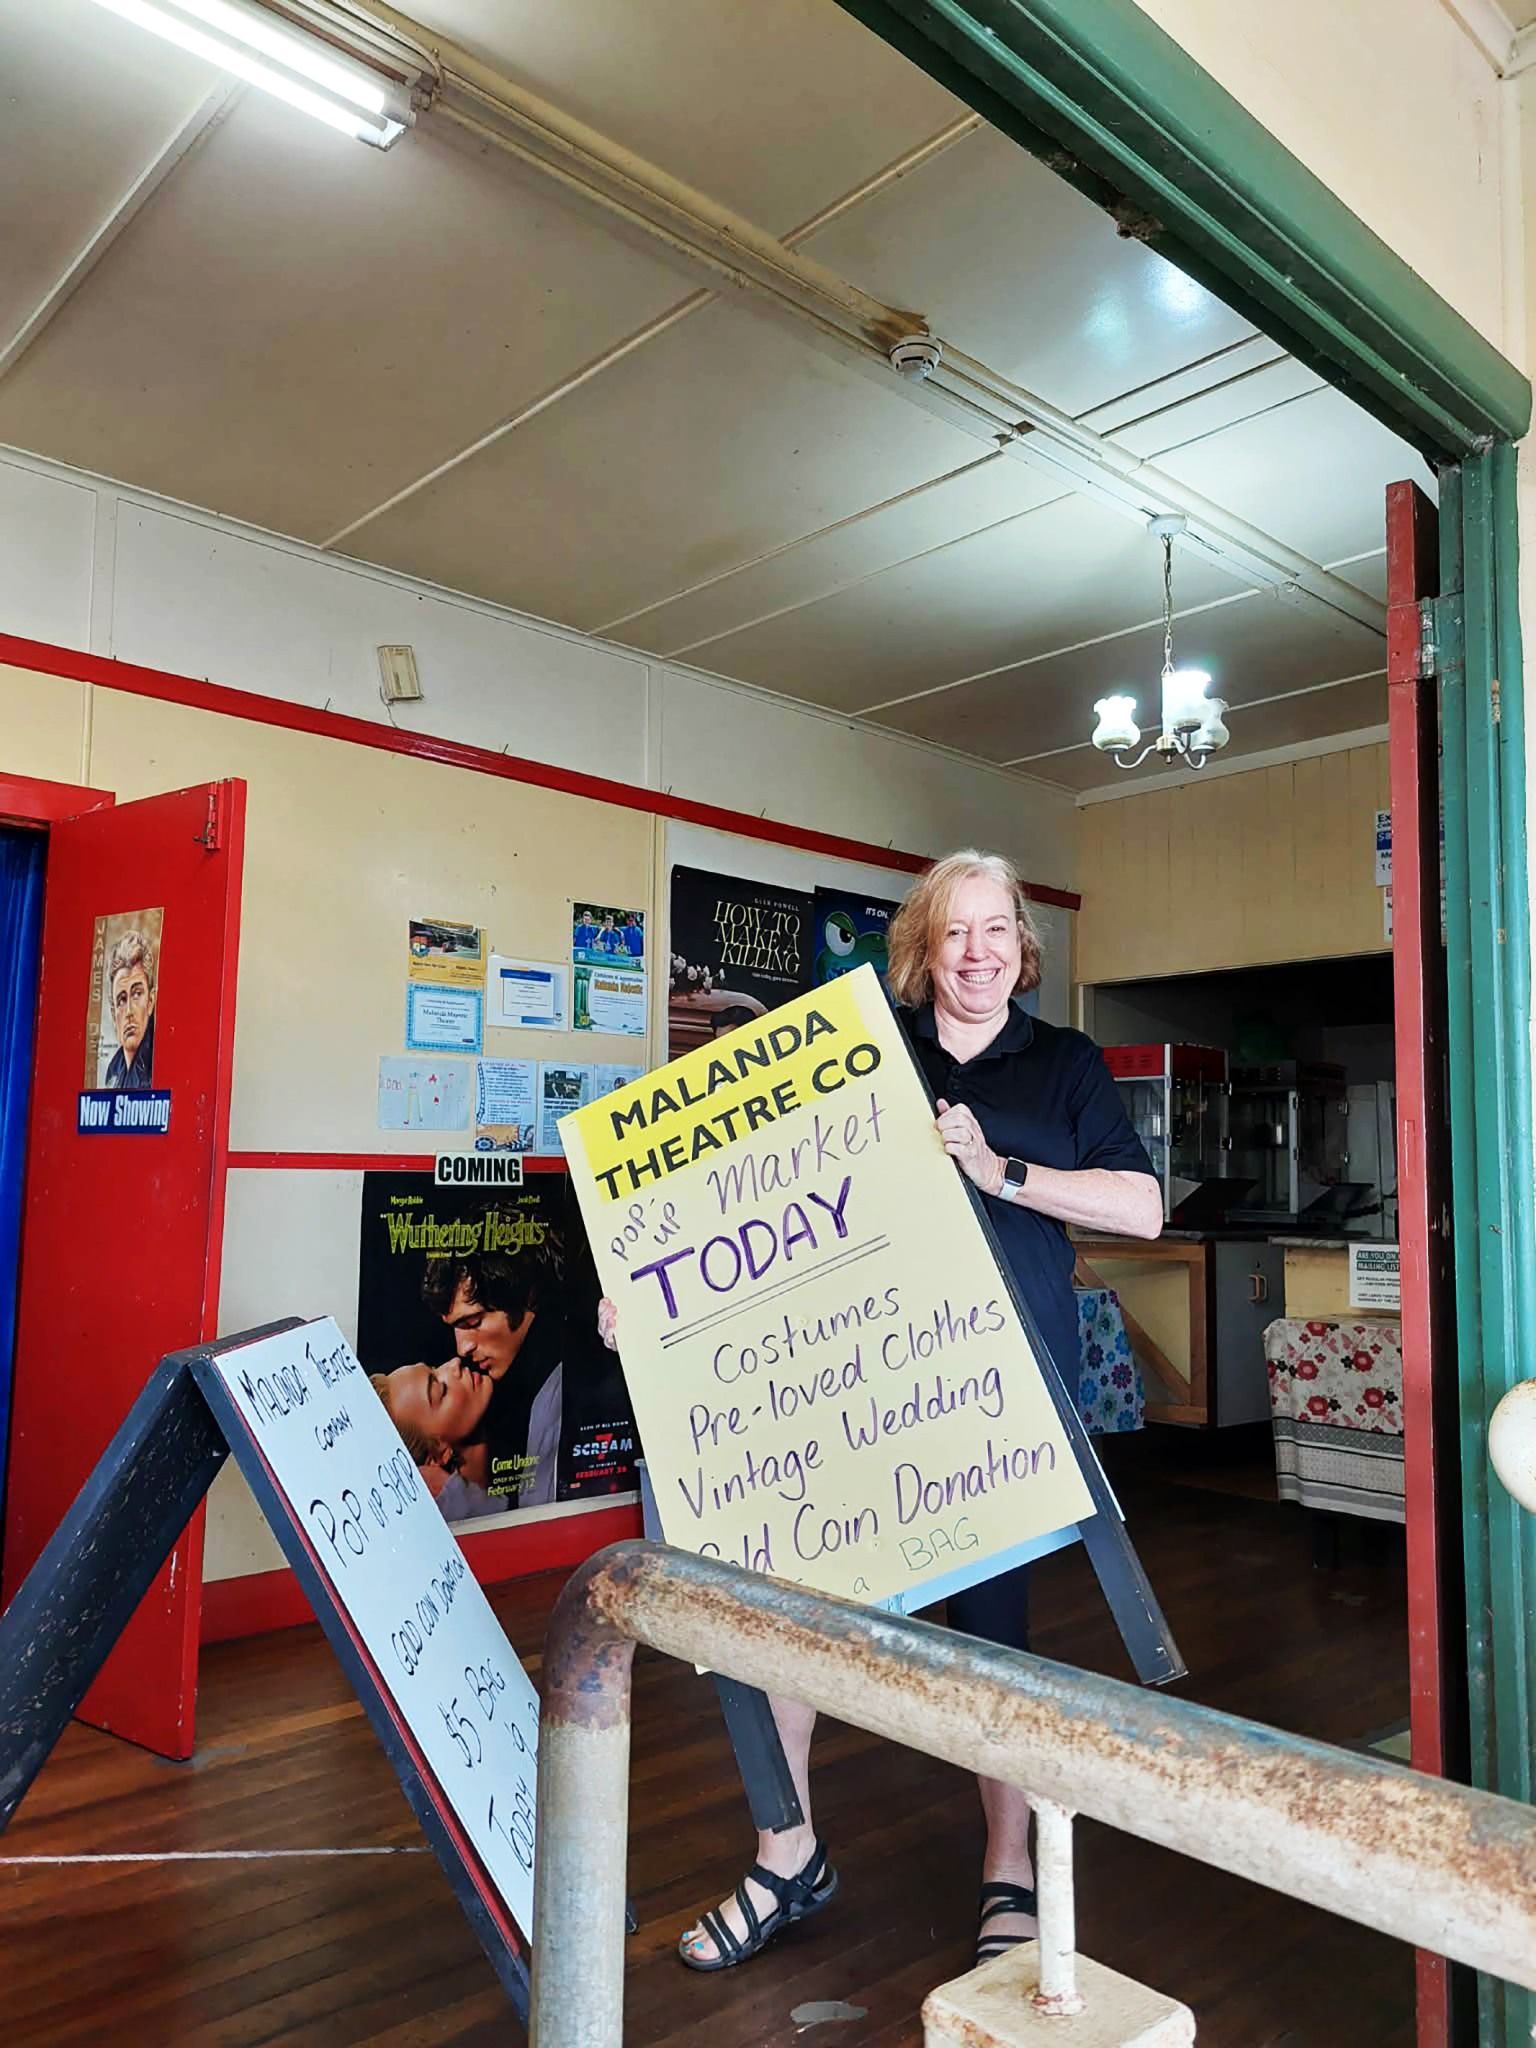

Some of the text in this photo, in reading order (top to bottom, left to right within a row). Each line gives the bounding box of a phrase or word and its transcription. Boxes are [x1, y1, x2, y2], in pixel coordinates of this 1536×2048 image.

[713, 900, 801, 936] HOW TO
[714, 921, 799, 954] MAKE A
[774, 902, 800, 912] POWELL
[92, 918, 106, 1001] JAMES
[720, 941, 801, 975] KILLING
[80, 1094, 170, 1132] Now Showing
[610, 1010, 838, 1141] MALANDA
[595, 1080, 802, 1200] THEATRE
[812, 1043, 882, 1094] CO
[438, 1156, 521, 1183] COMING
[630, 1175, 851, 1319] TODAY
[1385, 1252, 1396, 1260] ON
[713, 1287, 900, 1383] Costumes
[237, 1341, 357, 1426] MALANDA THEATRE
[690, 1299, 1006, 1455] Pre-loved Clothes
[491, 1454, 540, 1474] Come Undone
[572, 1437, 633, 1457] SCREAM
[575, 1467, 614, 1480] FEBRUARY
[678, 1366, 1005, 1519] Vintage Wedding
[309, 1447, 421, 1568] POP UP SHOP
[487, 1477, 536, 1497] February 12
[793, 1502, 879, 1561] Coin
[894, 1438, 1056, 1525] Donation
[852, 1516, 979, 1594] a BAG
[391, 1619, 423, 1676] GOLD
[437, 1658, 506, 1771] $5 BAG
[488, 1774, 537, 1877] TODAY
